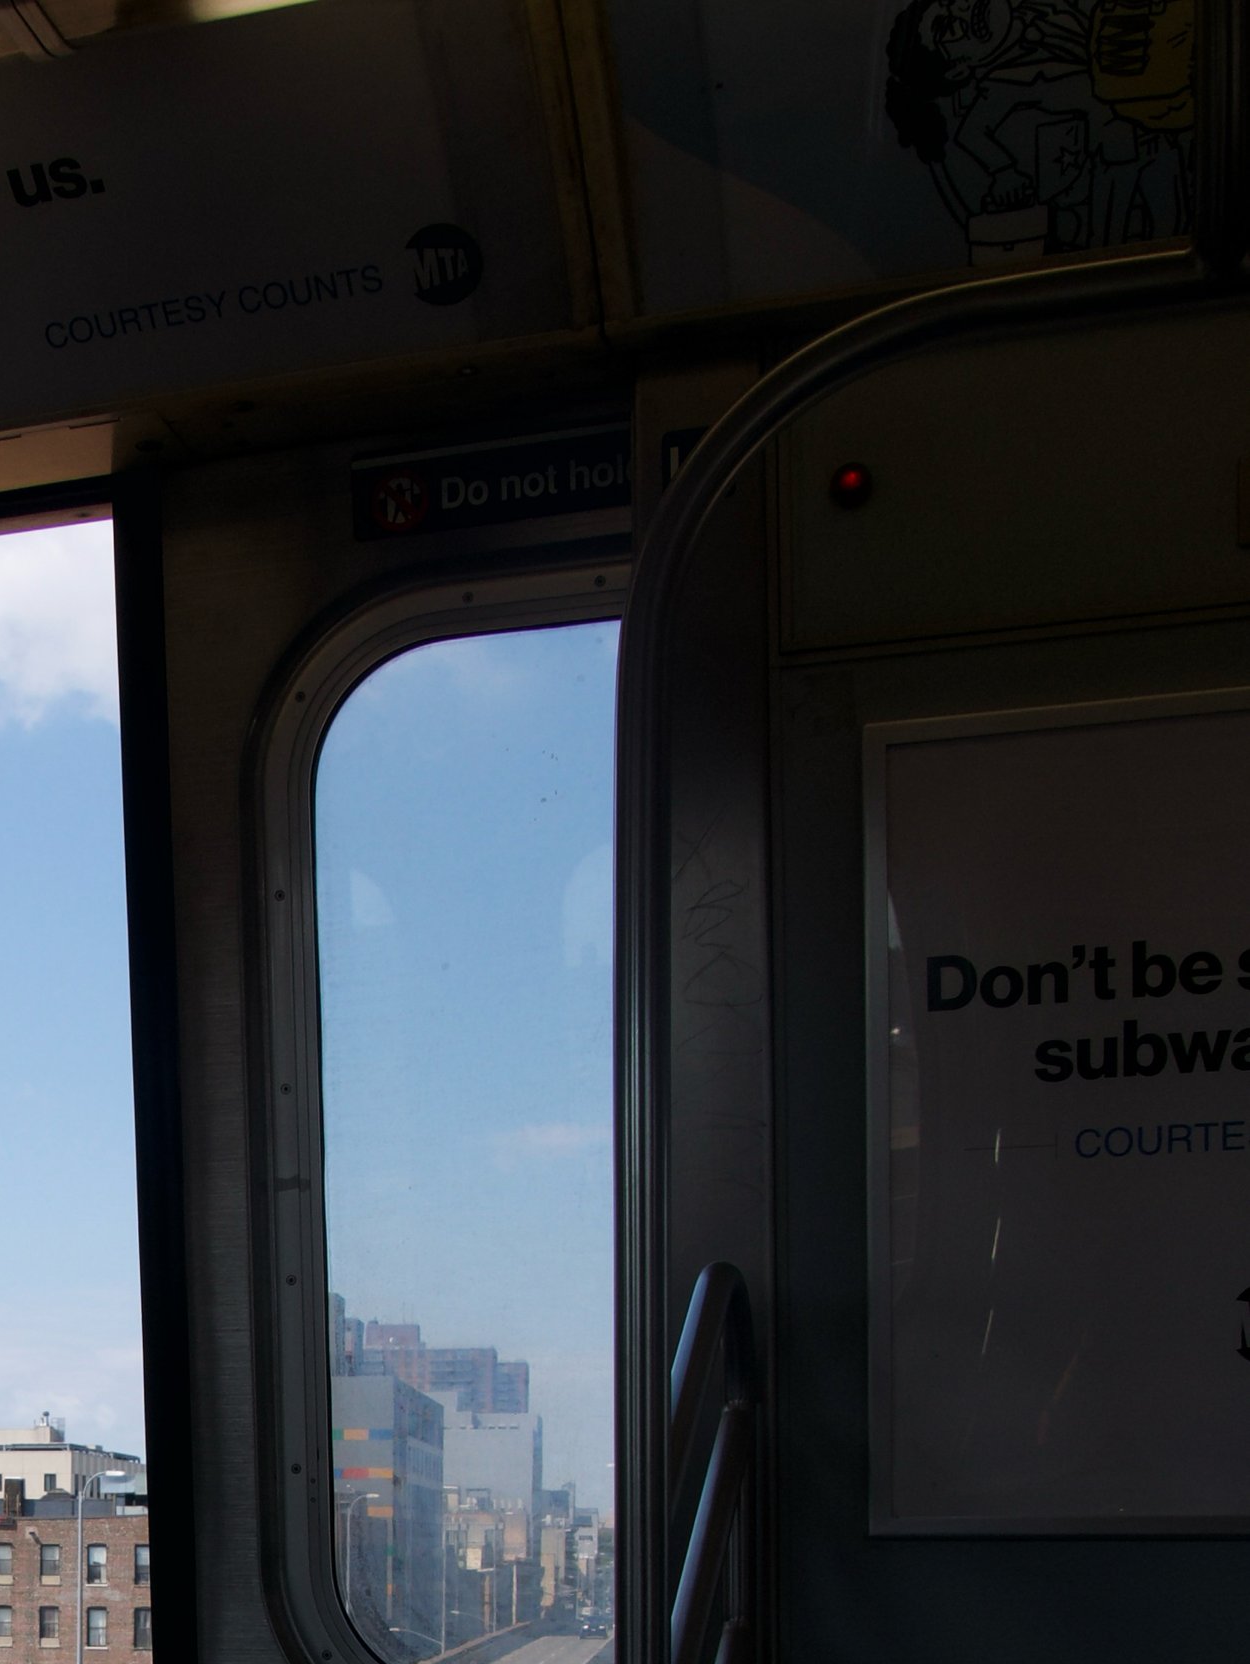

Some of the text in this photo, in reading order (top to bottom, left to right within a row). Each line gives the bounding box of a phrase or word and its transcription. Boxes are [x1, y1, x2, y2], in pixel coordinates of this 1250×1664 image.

[7, 158, 105, 208] us.
[45, 265, 383, 348] COURTESY COUNTS
[440, 475, 490, 510] Do
[501, 466, 558, 501] not
[569, 453, 630, 492] hol
[1132, 941, 1223, 998] be
